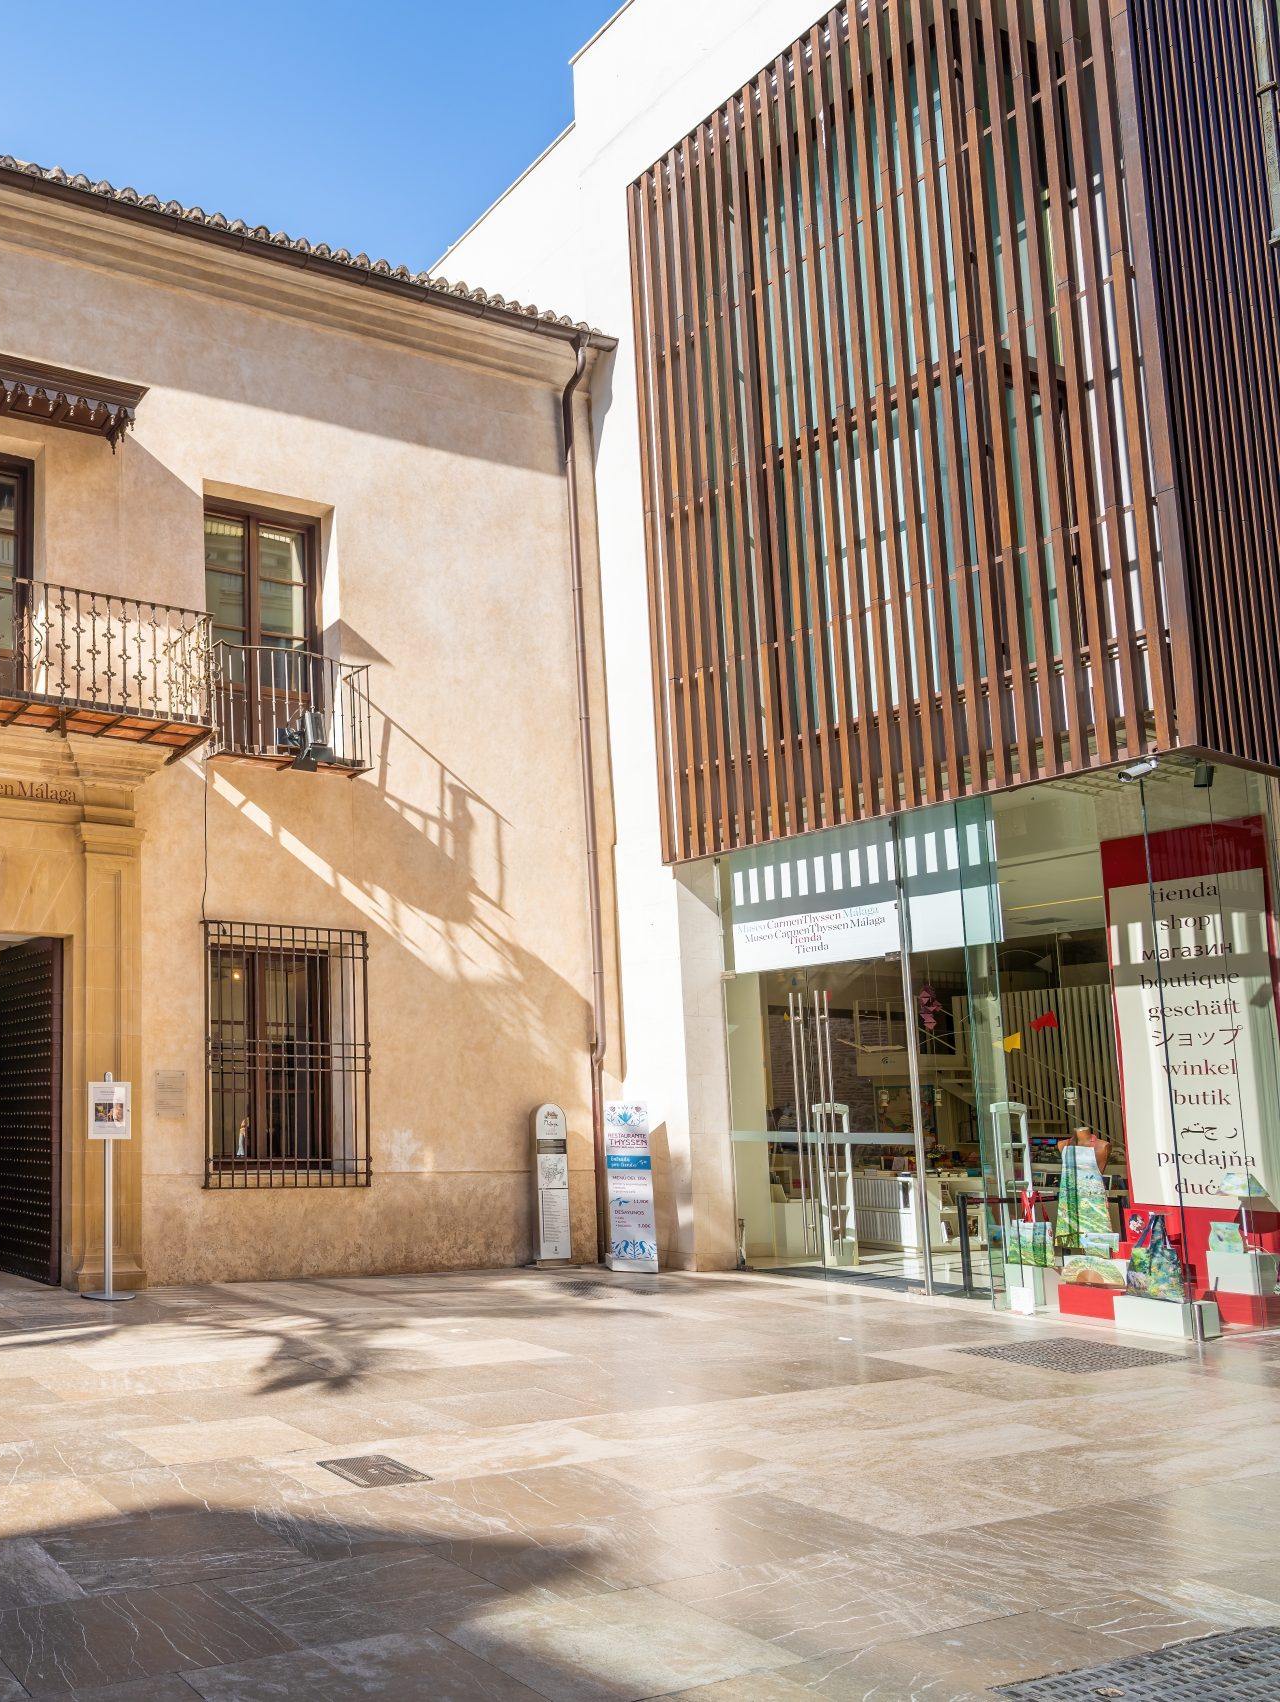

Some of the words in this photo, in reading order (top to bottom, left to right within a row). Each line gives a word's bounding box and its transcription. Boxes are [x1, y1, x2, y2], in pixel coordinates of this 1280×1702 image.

[17, 780, 78, 804] Málaga
[1148, 881, 1219, 903] tienda
[737, 924, 767, 934] Museo
[842, 905, 880, 919] Málaga
[1160, 914, 1211, 931] shop
[744, 933, 774, 944] Museo
[849, 916, 886, 929] Málaga
[787, 932, 822, 945] Tienda
[794, 942, 829, 955] Tienda
[1142, 942, 1233, 961] магазин
[1140, 971, 1240, 989] boutique
[1148, 998, 1241, 1022] geschäft
[1151, 1024, 1244, 1047] ショップ
[1162, 1058, 1237, 1076] winkel
[1172, 1089, 1232, 1105] butik
[1157, 1148, 1256, 1170] predajňa
[1174, 1178, 1220, 1195] duć
